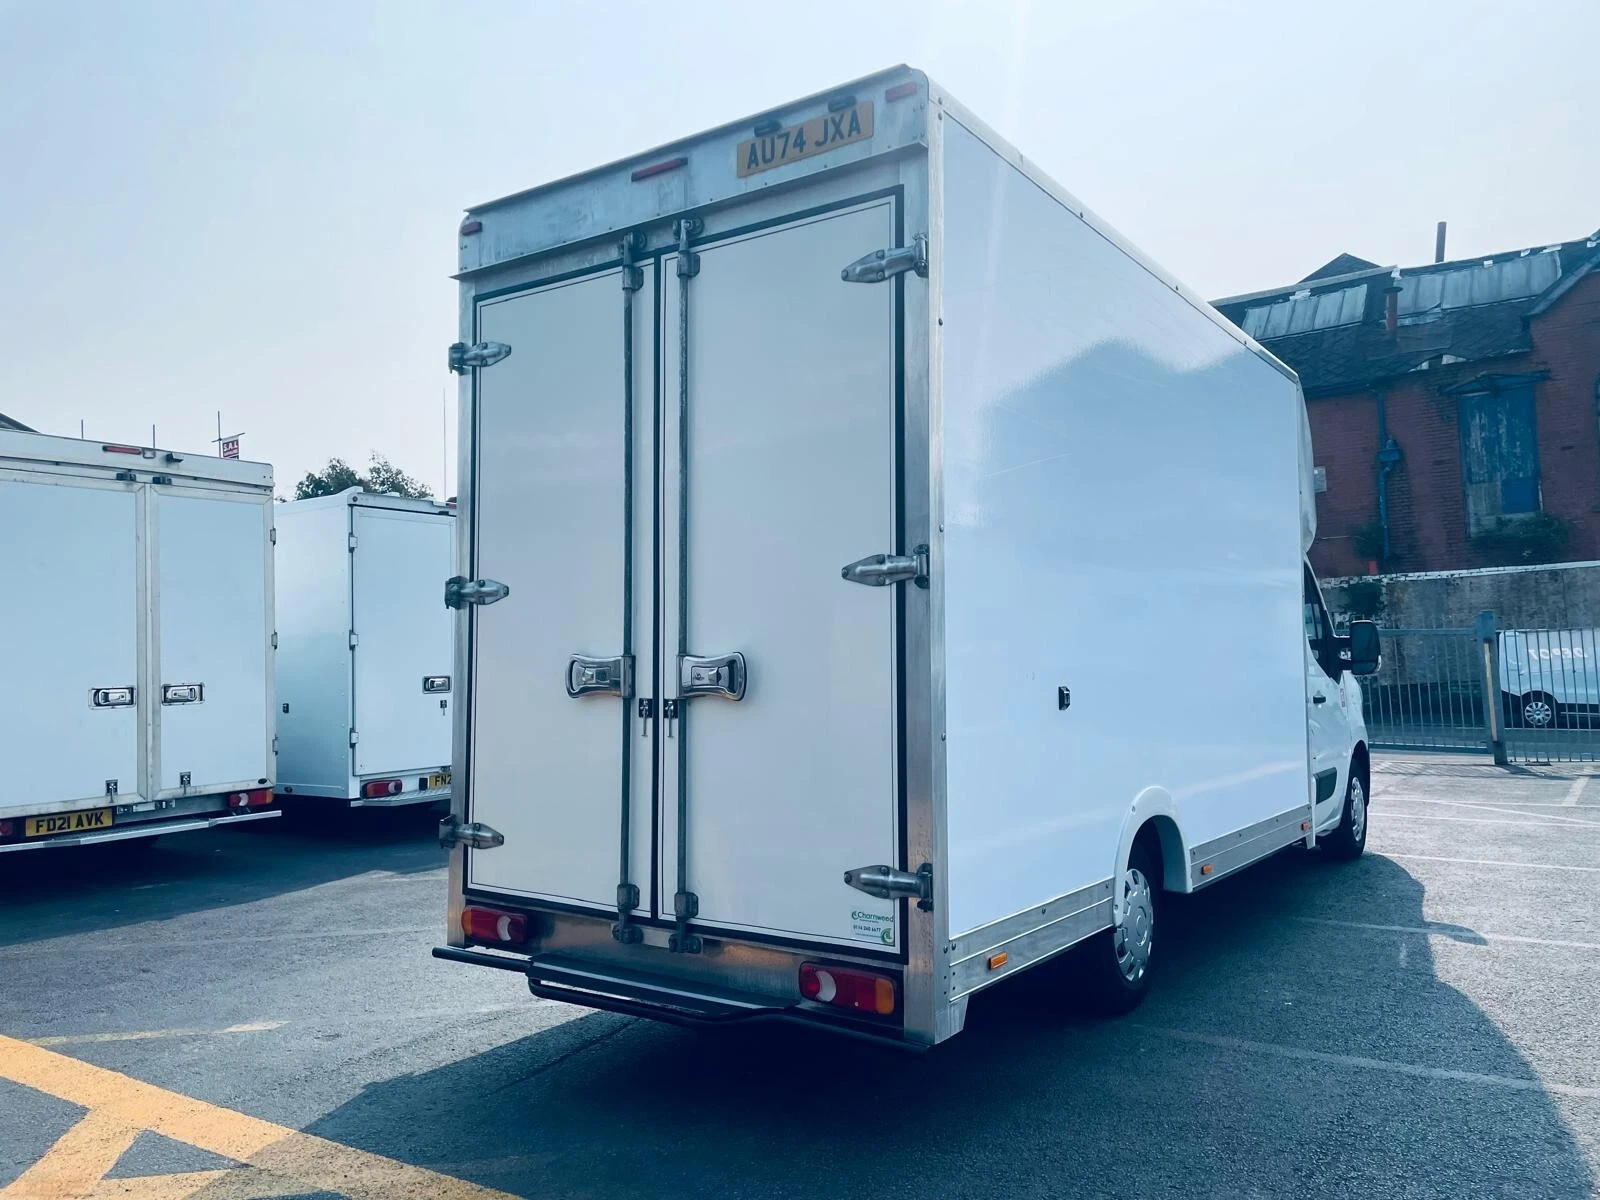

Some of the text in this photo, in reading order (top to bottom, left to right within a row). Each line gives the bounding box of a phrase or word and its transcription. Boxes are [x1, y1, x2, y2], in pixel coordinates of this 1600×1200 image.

[747, 110, 861, 170] AU74 JXA
[35, 811, 104, 833] FD21 AVK
